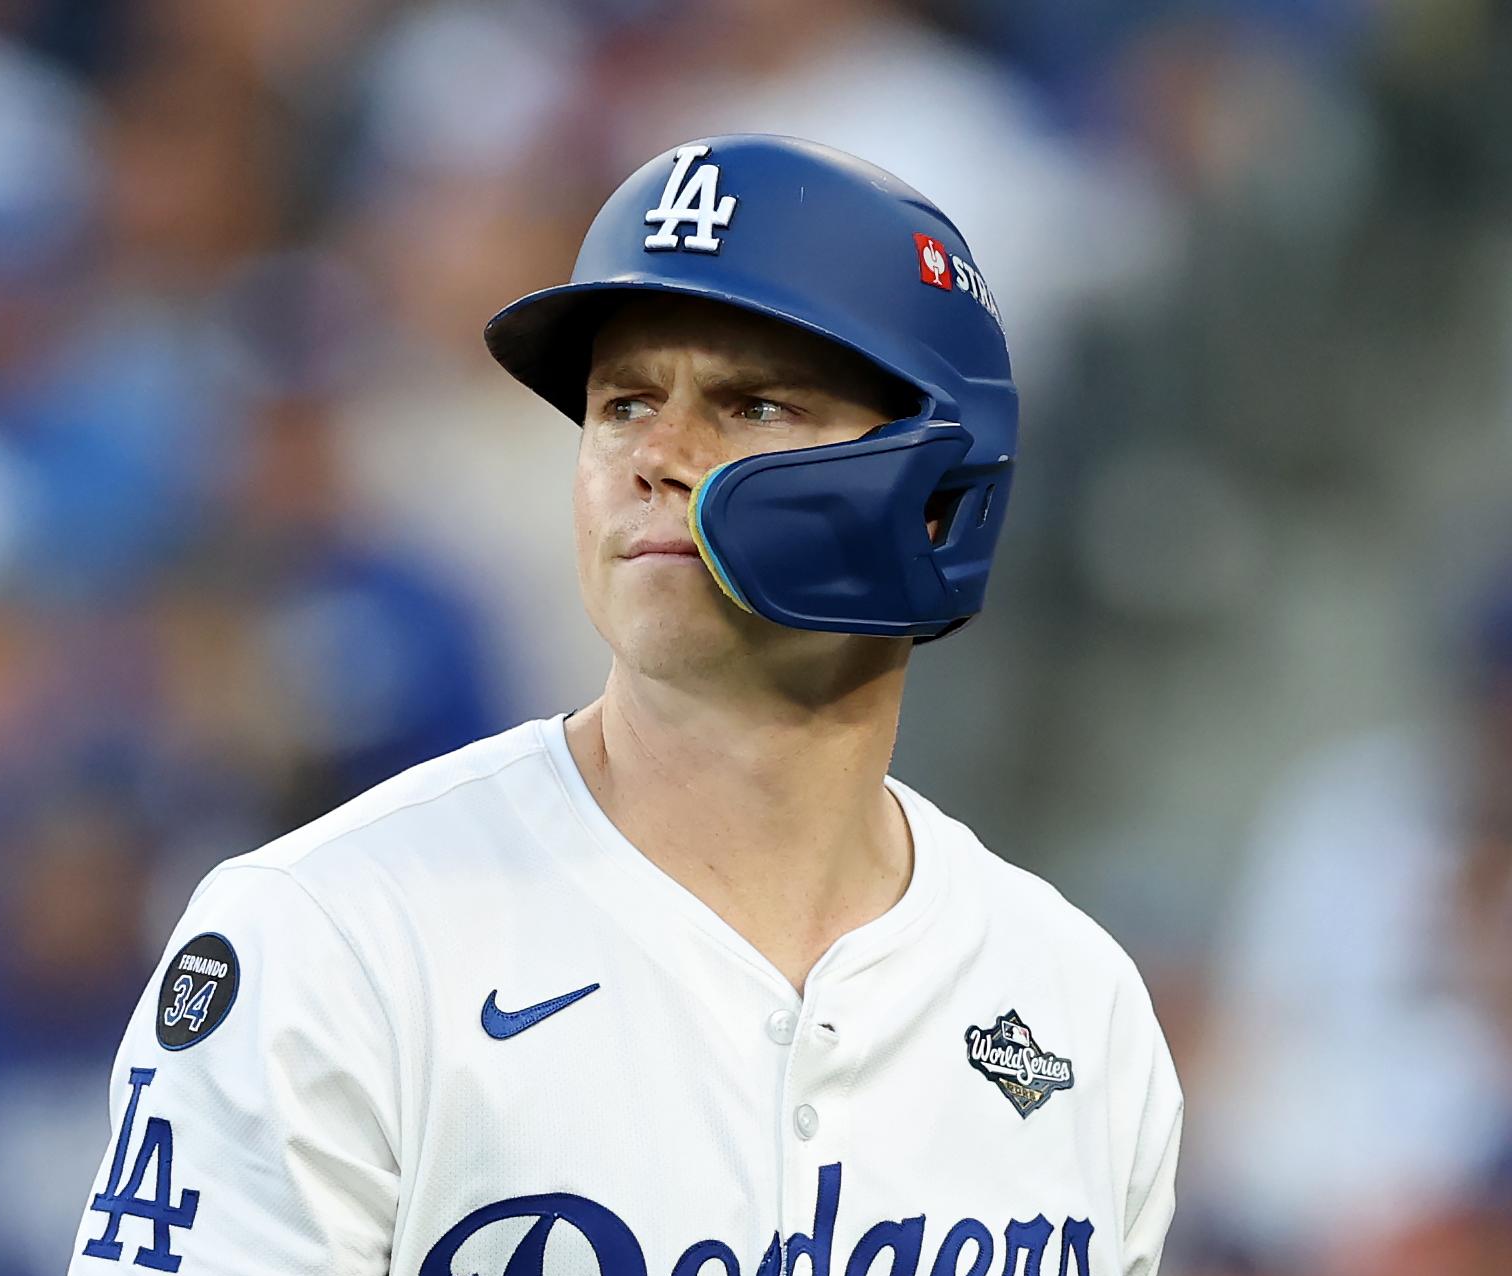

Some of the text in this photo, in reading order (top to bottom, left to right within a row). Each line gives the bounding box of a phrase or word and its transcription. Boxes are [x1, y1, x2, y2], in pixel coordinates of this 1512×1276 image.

[644, 144, 737, 251] LA
[178, 954, 228, 978] FERNANDO
[164, 974, 218, 1032] 34
[969, 1029, 1070, 1086] World Series
[82, 1067, 200, 1274] LA
